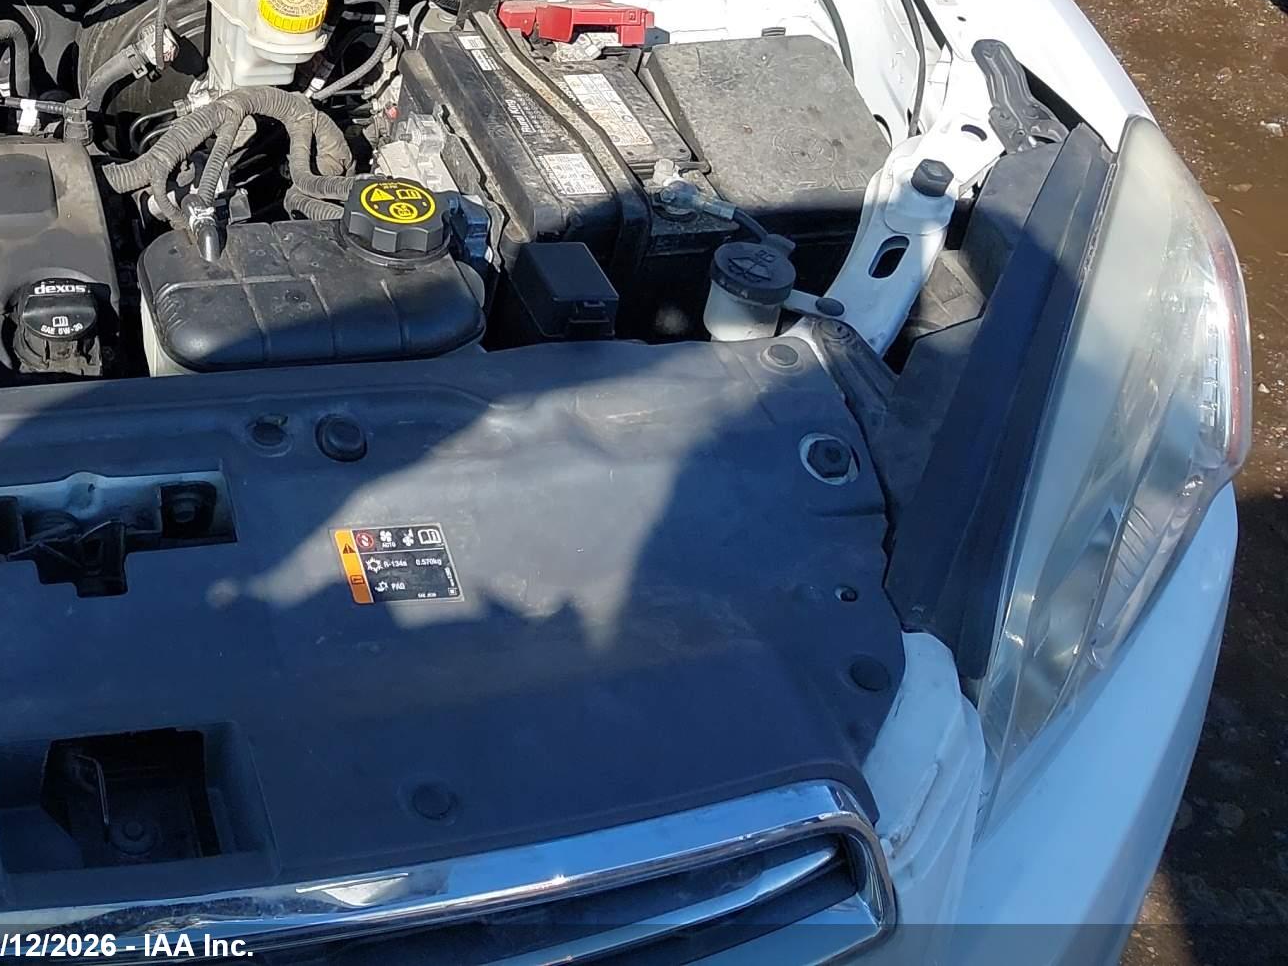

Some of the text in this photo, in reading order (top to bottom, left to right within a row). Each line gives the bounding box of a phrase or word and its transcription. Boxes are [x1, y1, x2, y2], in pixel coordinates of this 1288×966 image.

[505, 99, 533, 133] Rural King
[34, 282, 87, 295] dexos
